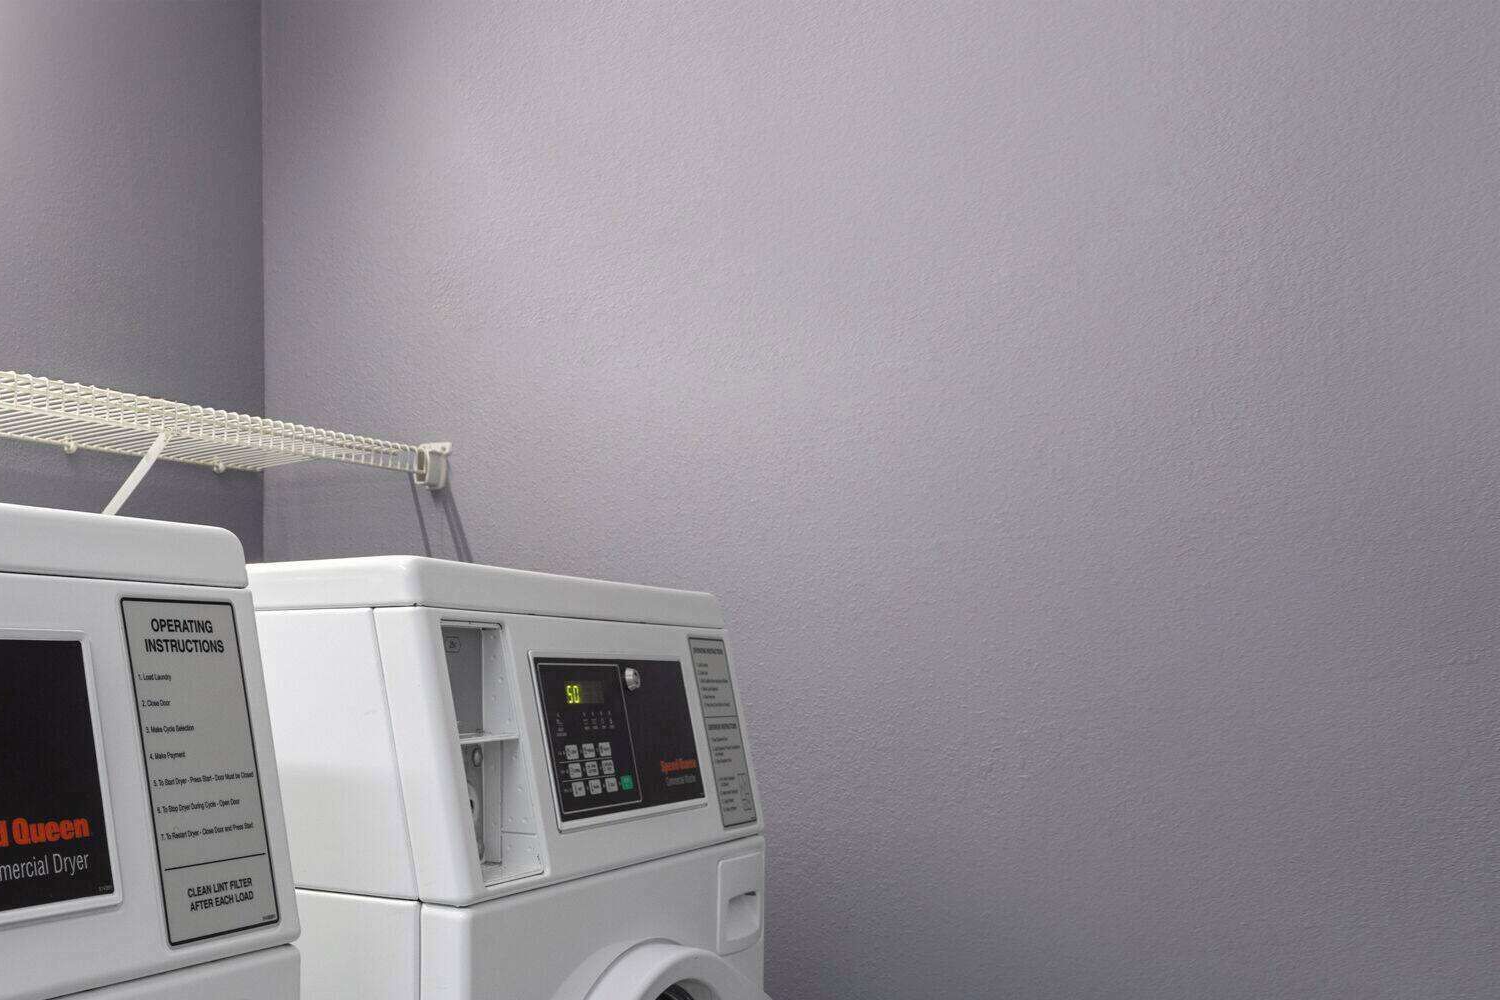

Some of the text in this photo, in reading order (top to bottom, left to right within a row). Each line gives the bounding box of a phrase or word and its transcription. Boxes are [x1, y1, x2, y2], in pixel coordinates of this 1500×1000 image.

[150, 618, 213, 634] OPERATING
[144, 638, 224, 653] INSTRUCTIONS
[12, 817, 91, 845] Queen
[53, 852, 90, 876] Dryer
[187, 877, 253, 898] CLEAN LINT FILTER
[190, 891, 254, 912] AFTER EACH LOAD
